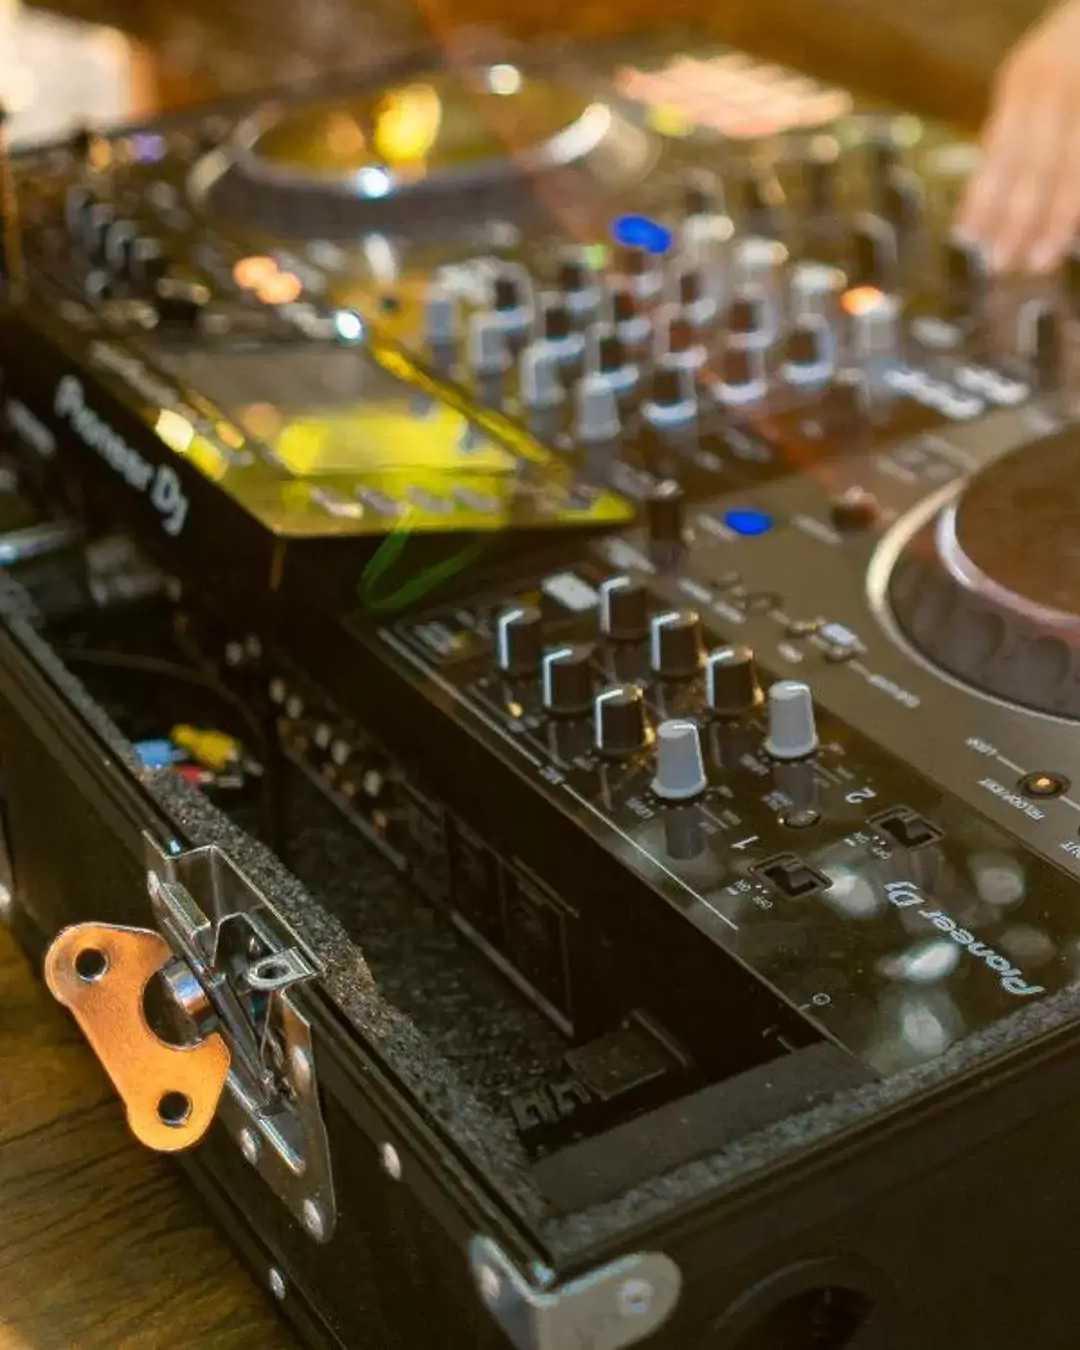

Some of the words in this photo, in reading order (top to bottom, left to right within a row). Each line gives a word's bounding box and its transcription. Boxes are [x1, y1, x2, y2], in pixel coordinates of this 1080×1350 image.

[845, 786, 877, 804] 2
[731, 835, 759, 850] 1
[883, 880, 925, 908] DJ
[917, 909, 1045, 995] Pioneer
